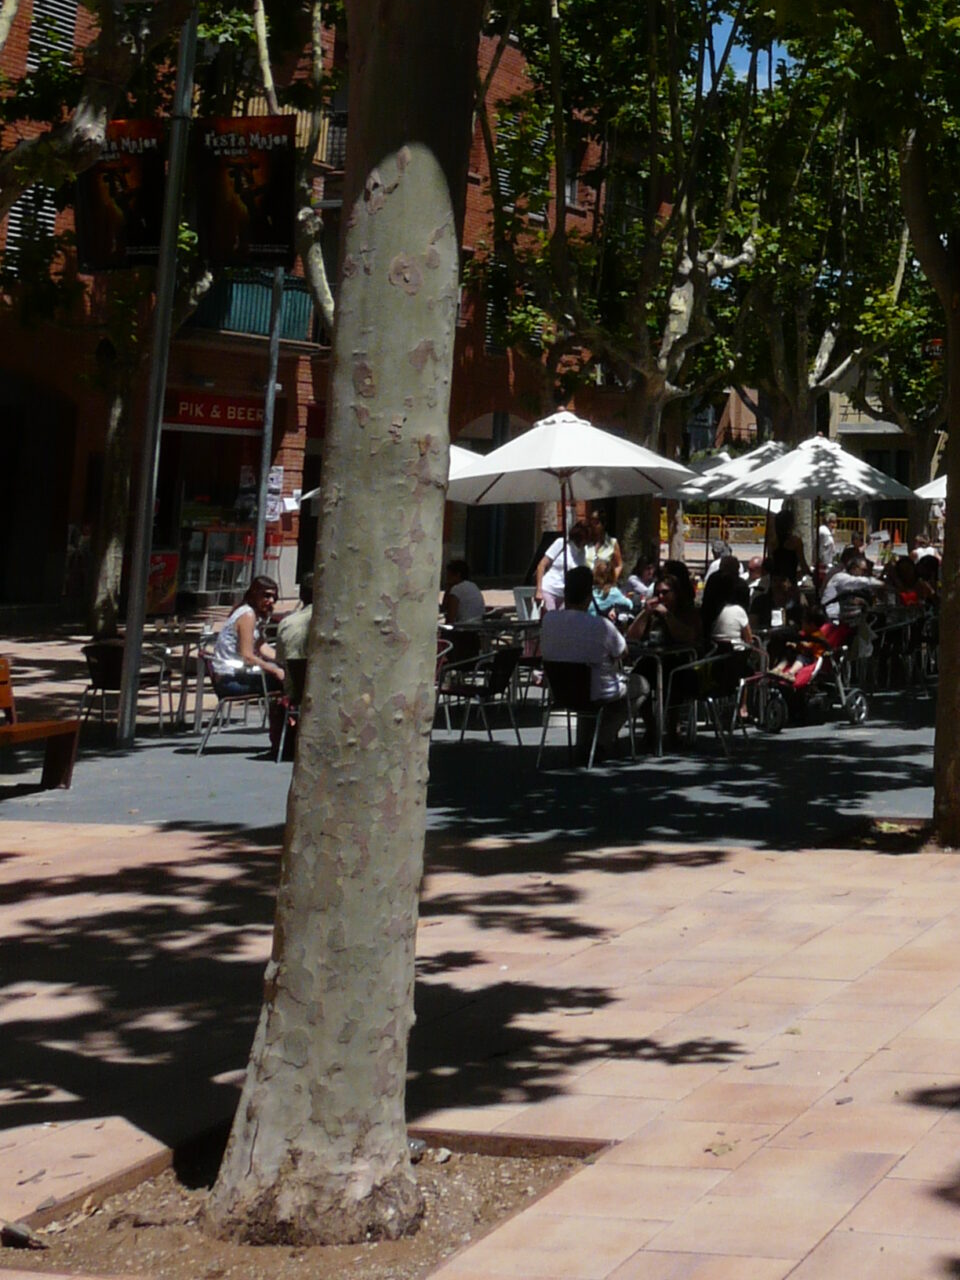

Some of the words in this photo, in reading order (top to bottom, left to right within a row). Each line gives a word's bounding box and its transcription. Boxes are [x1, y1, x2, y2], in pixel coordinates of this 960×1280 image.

[179, 402, 205, 418] PIK
[210, 405, 220, 419] &
[227, 406, 264, 422] BEER
